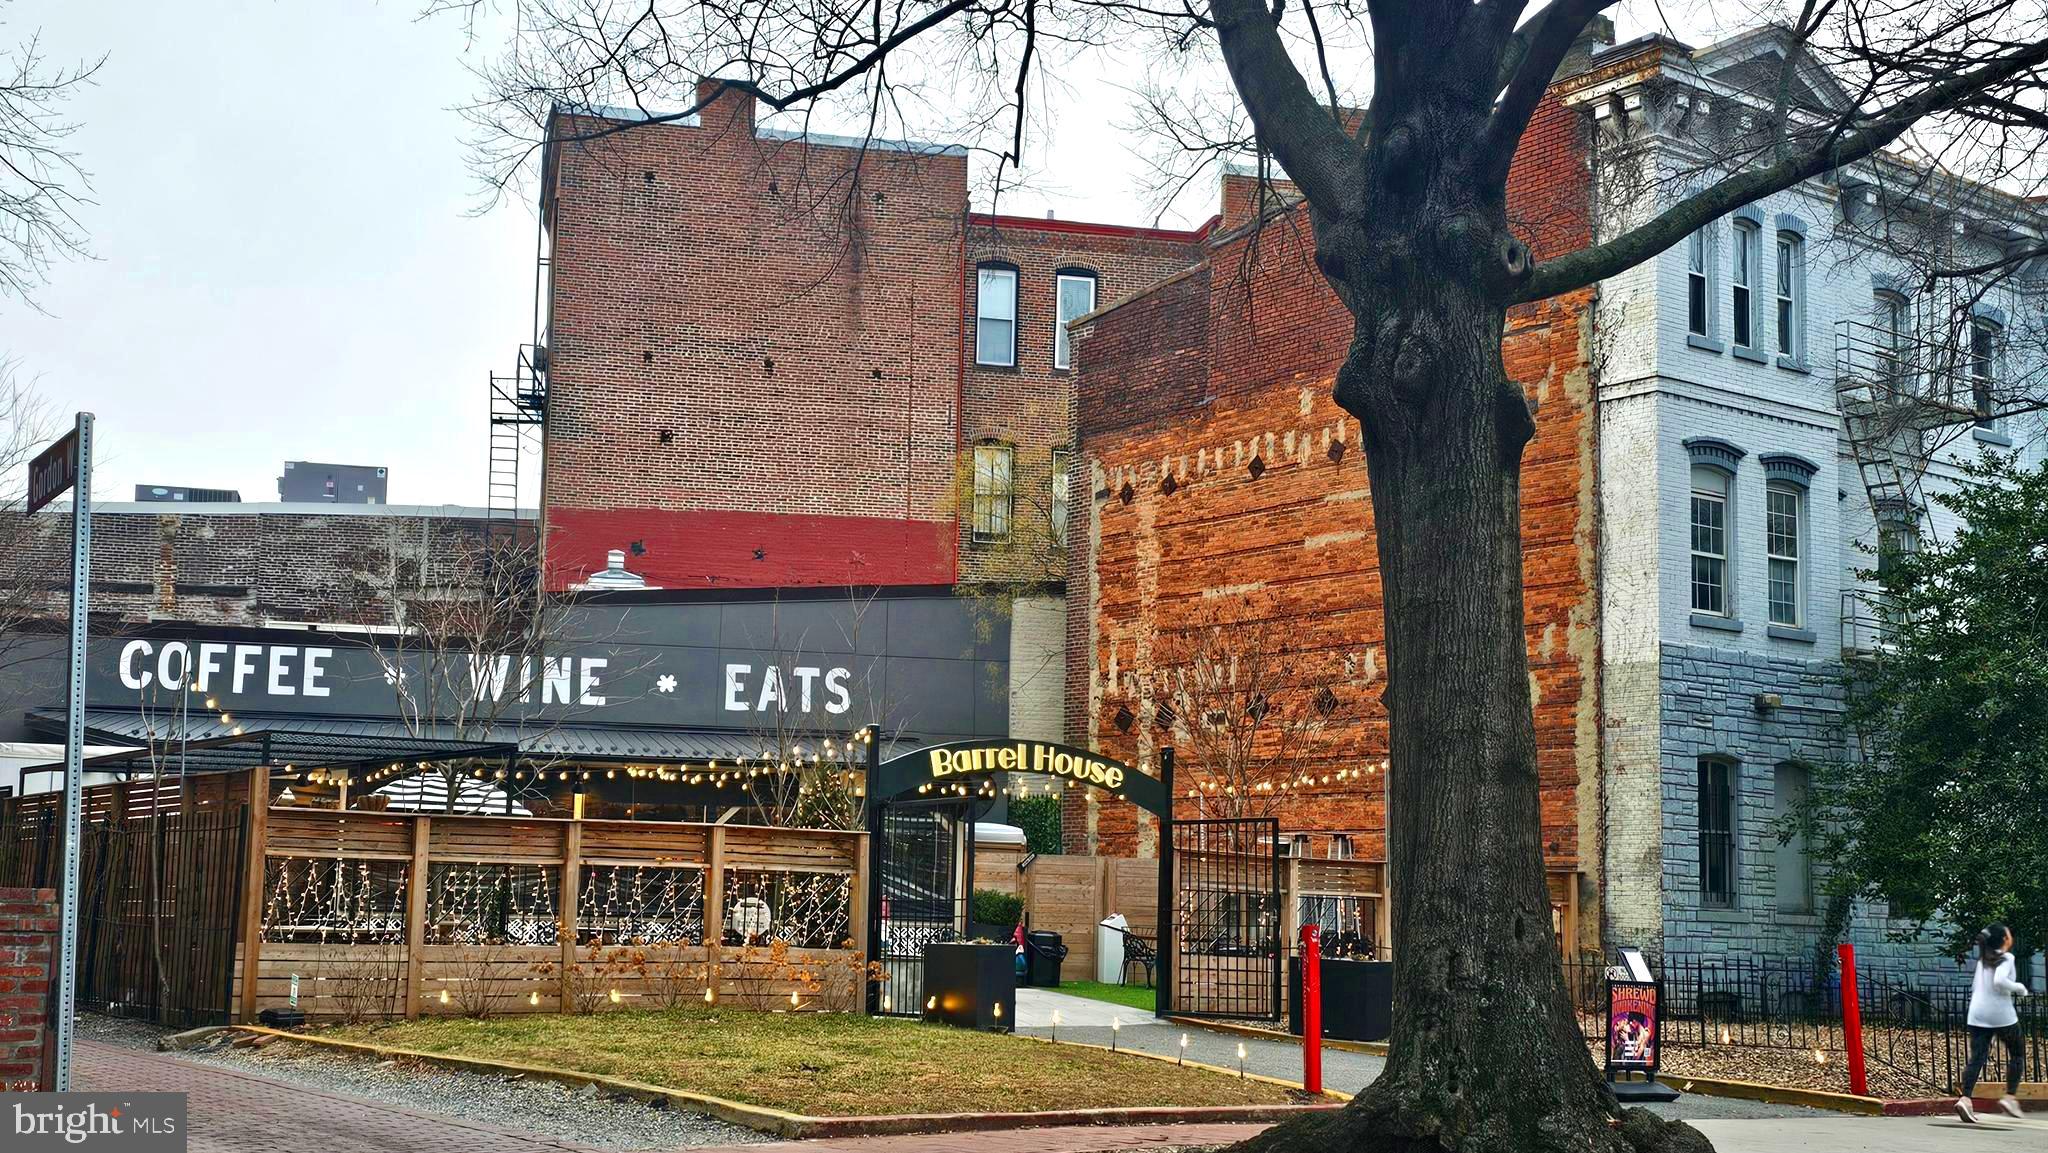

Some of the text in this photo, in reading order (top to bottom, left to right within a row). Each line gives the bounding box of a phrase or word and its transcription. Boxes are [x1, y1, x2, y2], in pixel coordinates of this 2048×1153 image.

[32, 457, 63, 504] Gordon
[118, 639, 852, 715] COFFEE WINE EATS
[929, 743, 1124, 789] Barrel House
[1611, 987, 1657, 1005] SHREWD
